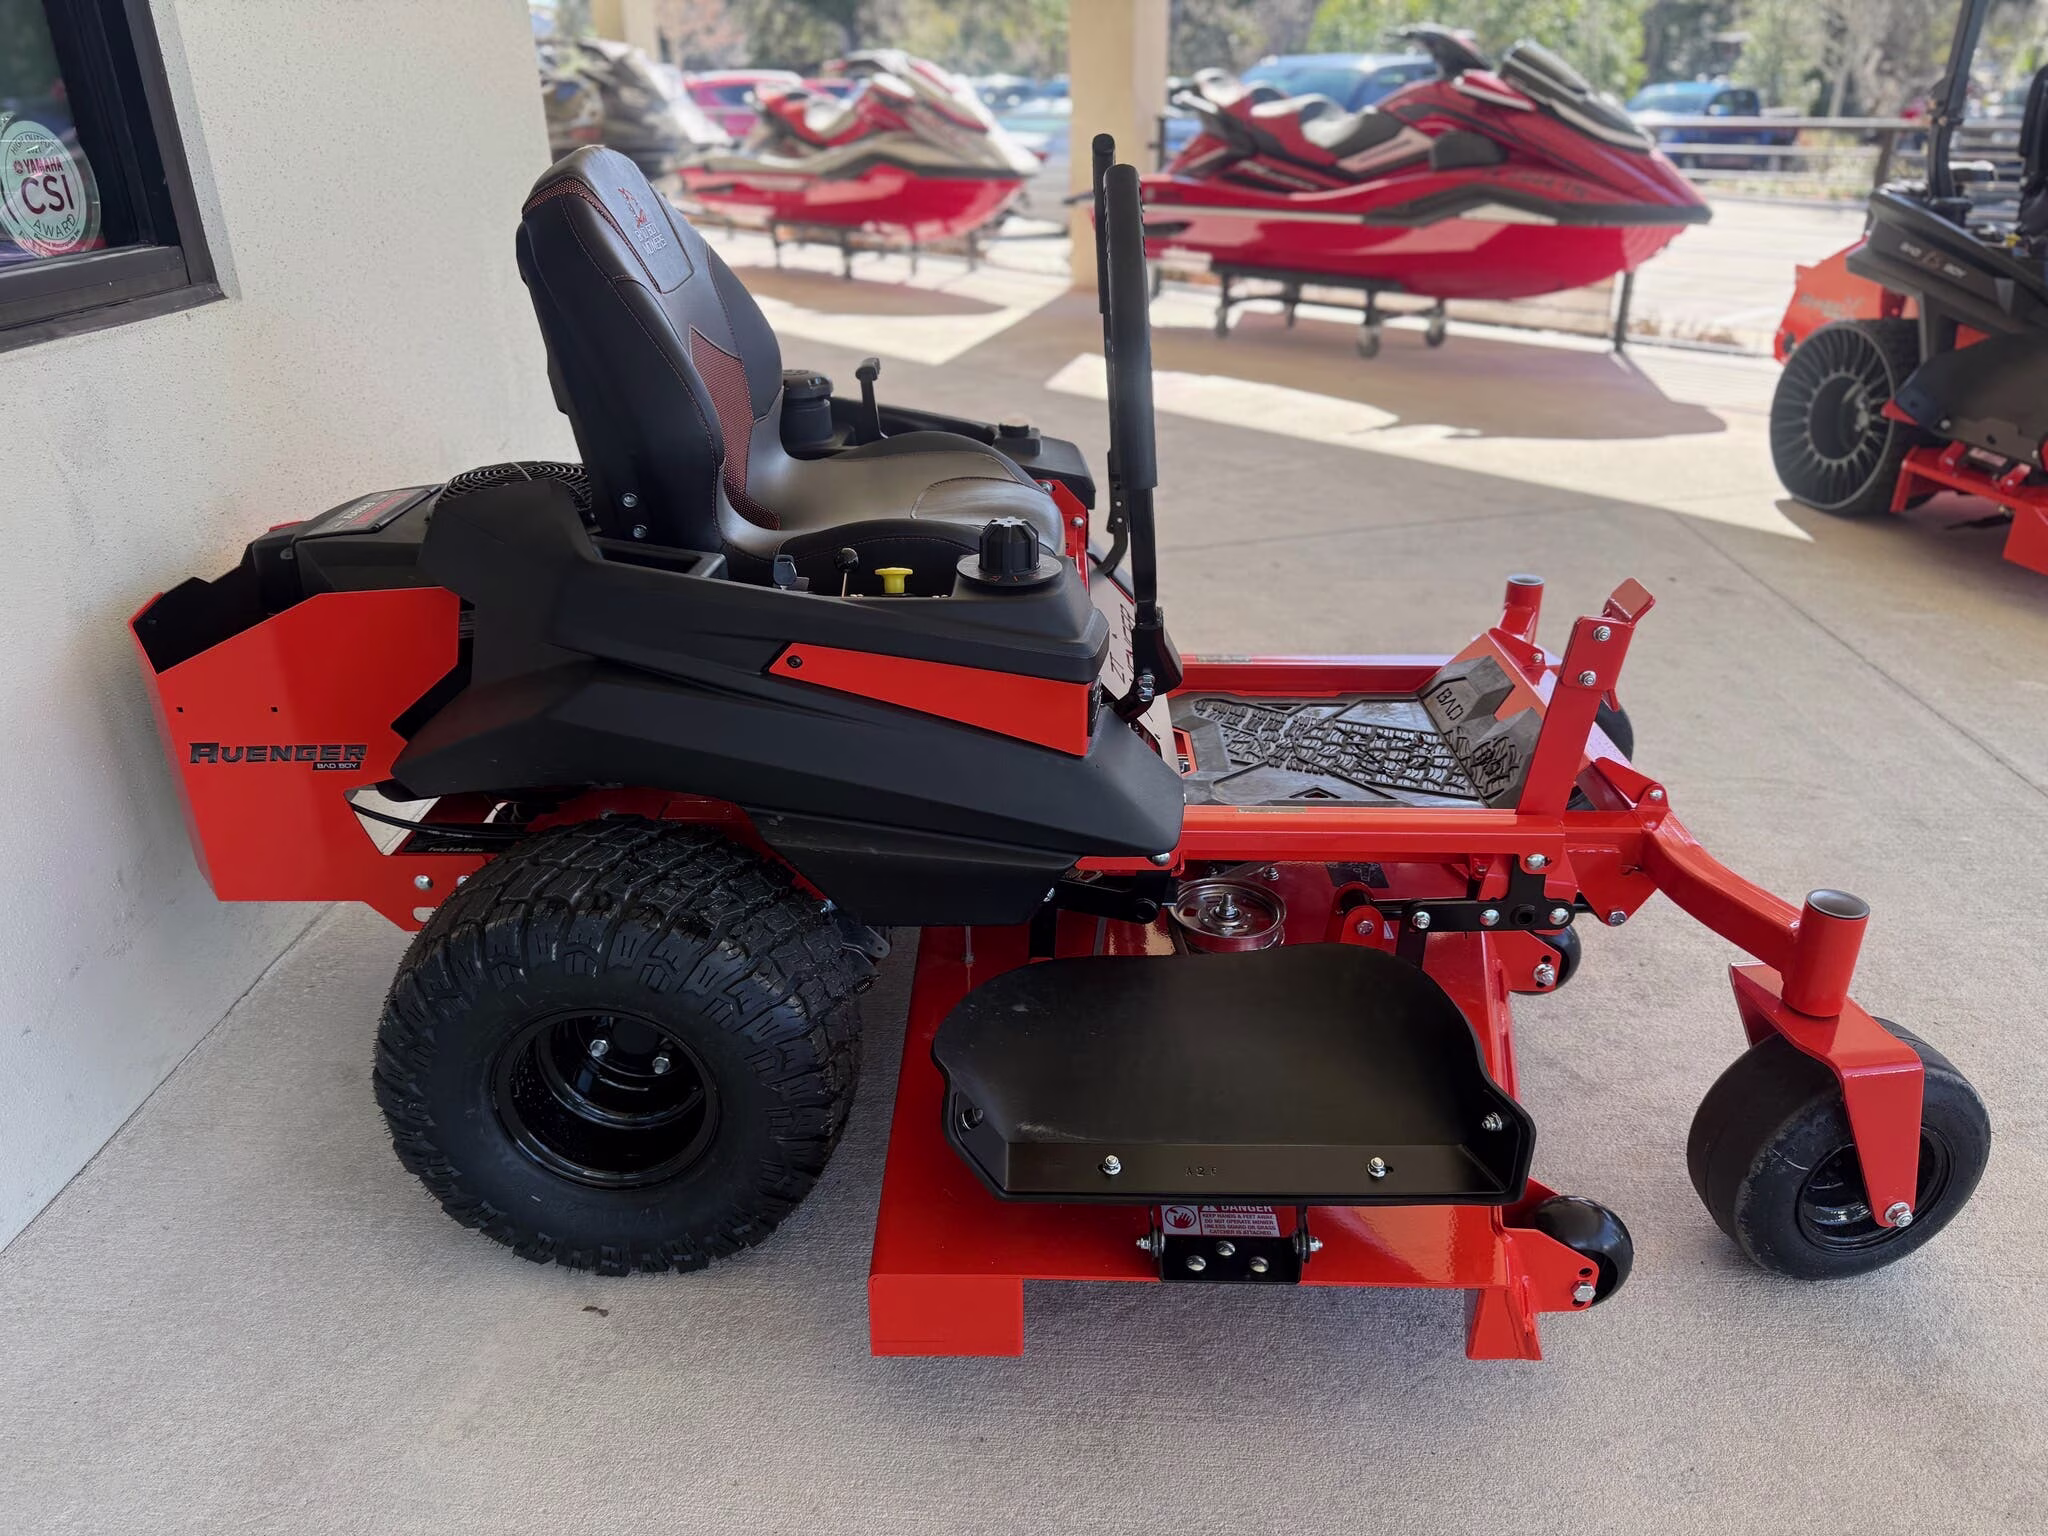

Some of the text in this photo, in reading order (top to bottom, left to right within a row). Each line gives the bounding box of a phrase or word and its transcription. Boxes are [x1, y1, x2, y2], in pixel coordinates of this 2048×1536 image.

[23, 156, 63, 175] YAMAHA
[20, 174, 75, 215] CSI
[33, 213, 76, 238] AWARD
[1436, 687, 1464, 720] BAD
[317, 762, 336, 770] BAD
